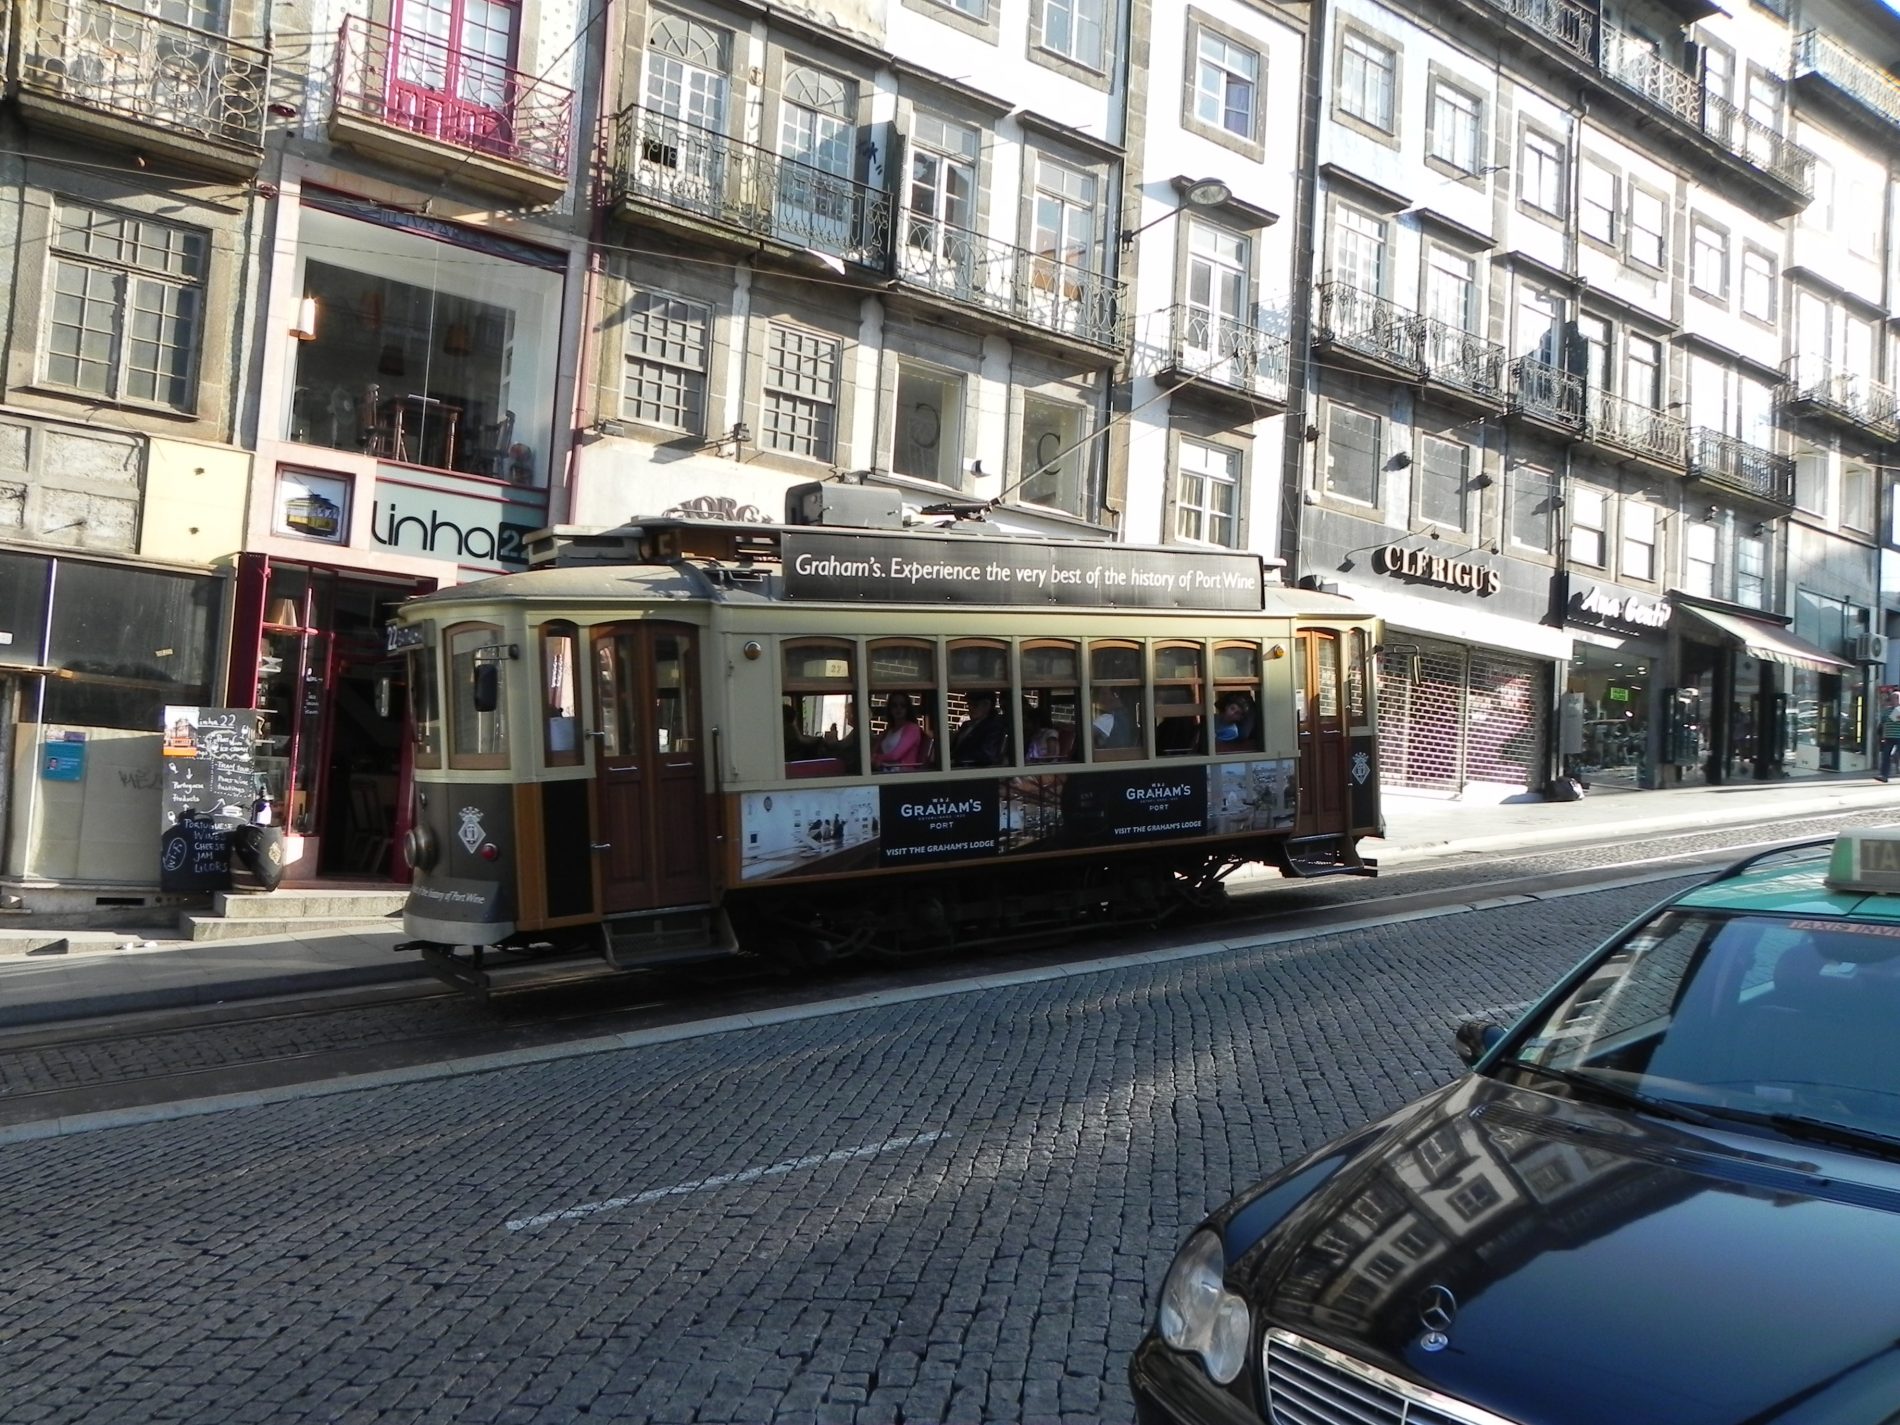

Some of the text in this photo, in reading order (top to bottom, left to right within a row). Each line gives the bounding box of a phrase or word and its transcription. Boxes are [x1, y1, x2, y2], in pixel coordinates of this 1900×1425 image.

[371, 500, 529, 560] linha 2
[795, 553, 1256, 592] Graham's. Experience the very best of the history of Port Wine
[220, 714, 236, 727] 22
[1126, 784, 1191, 800] GRAHAM'S
[900, 799, 982, 817] GRAHAM'S
[929, 821, 954, 830] PORT
[1114, 820, 1202, 835] VISIT THE GRAHAM'S LODGE
[886, 839, 995, 856] VISIT THE GRAHAM'S LODGE
